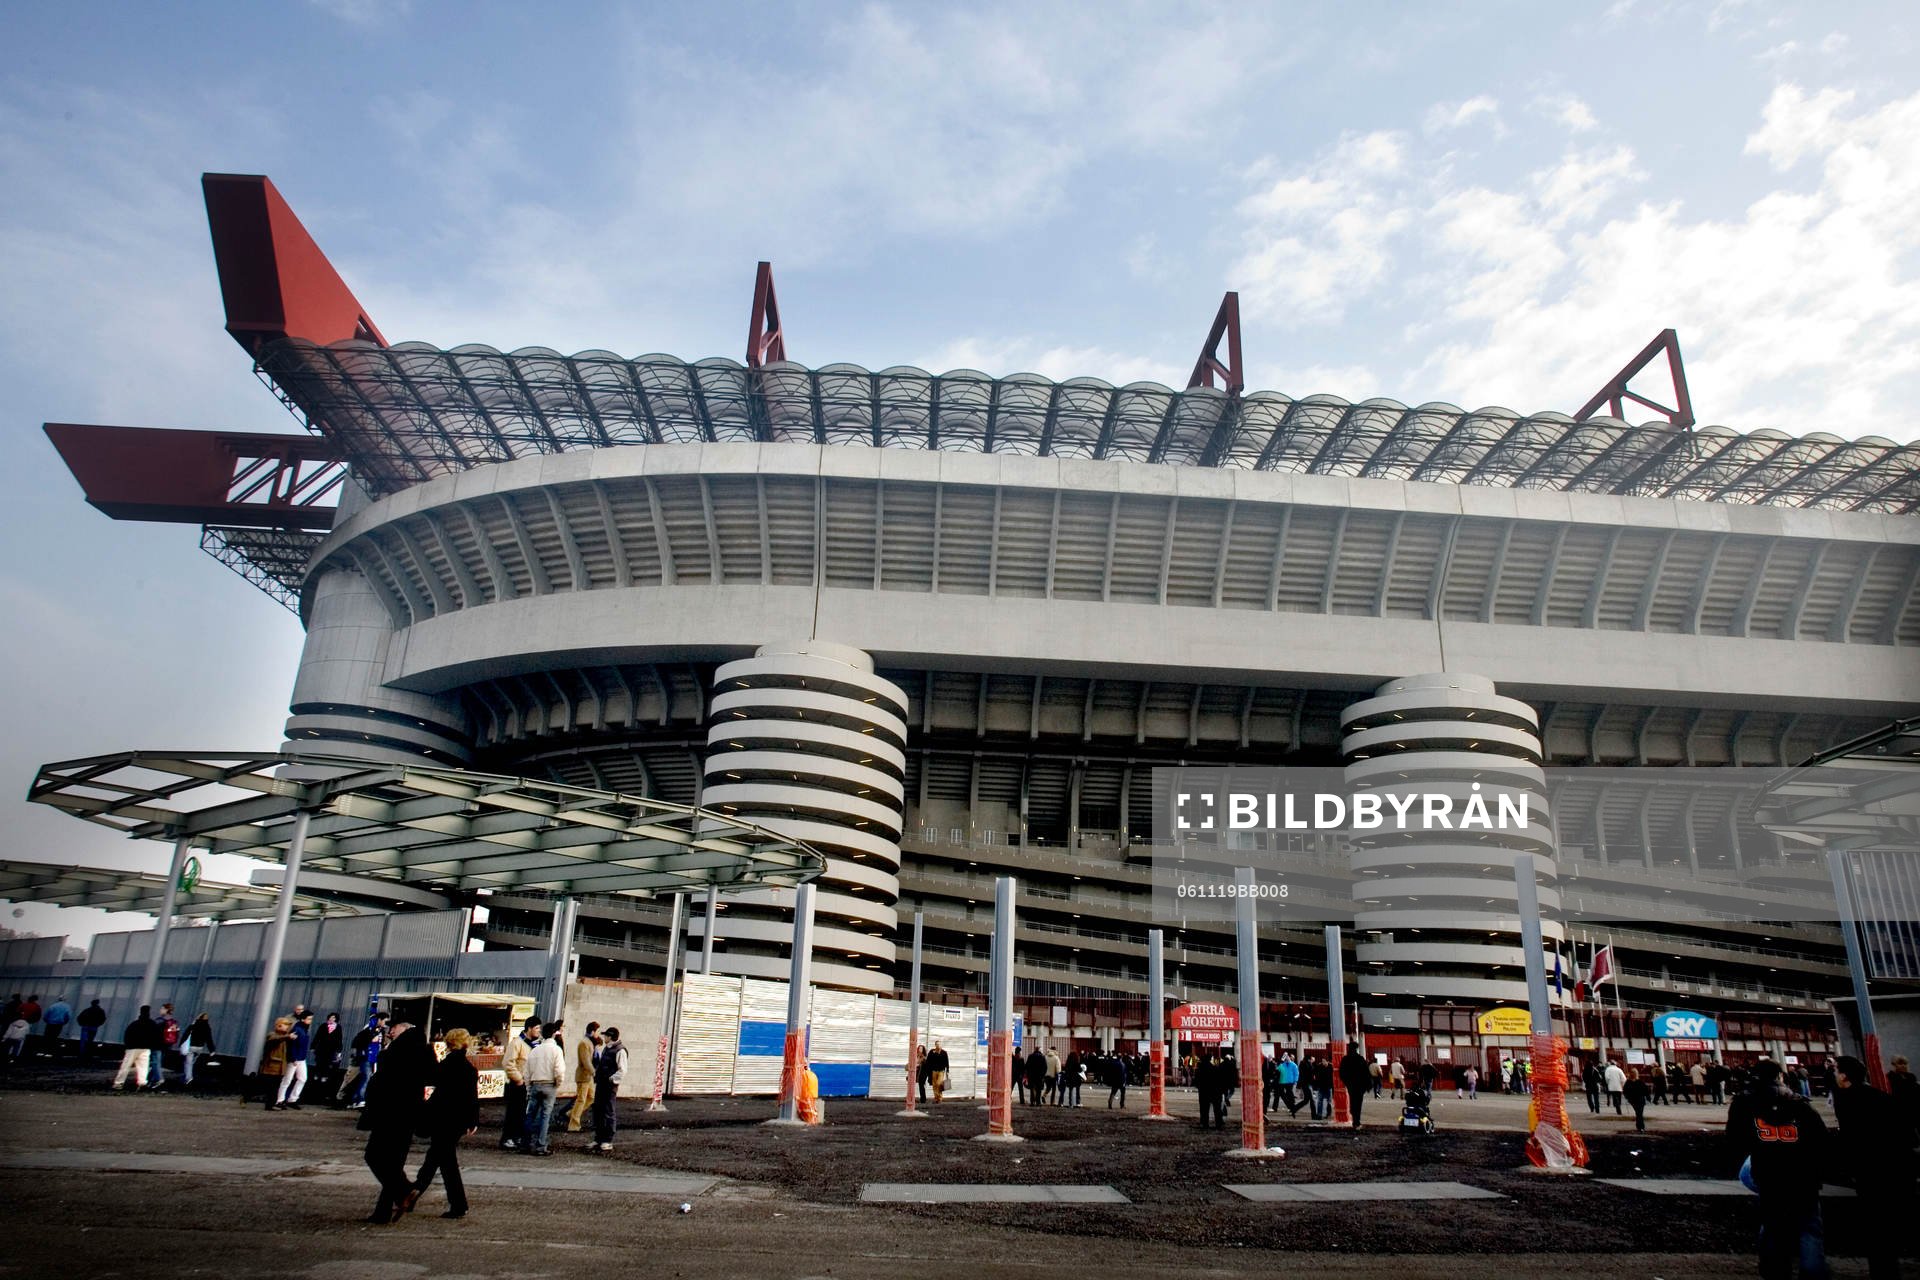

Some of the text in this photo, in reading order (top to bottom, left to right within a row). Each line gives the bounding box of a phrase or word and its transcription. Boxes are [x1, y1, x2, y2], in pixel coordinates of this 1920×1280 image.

[1189, 1004, 1226, 1016] BIRRA
[1180, 1016, 1235, 1028] MORETTI
[1665, 1016, 1707, 1037] SKY
